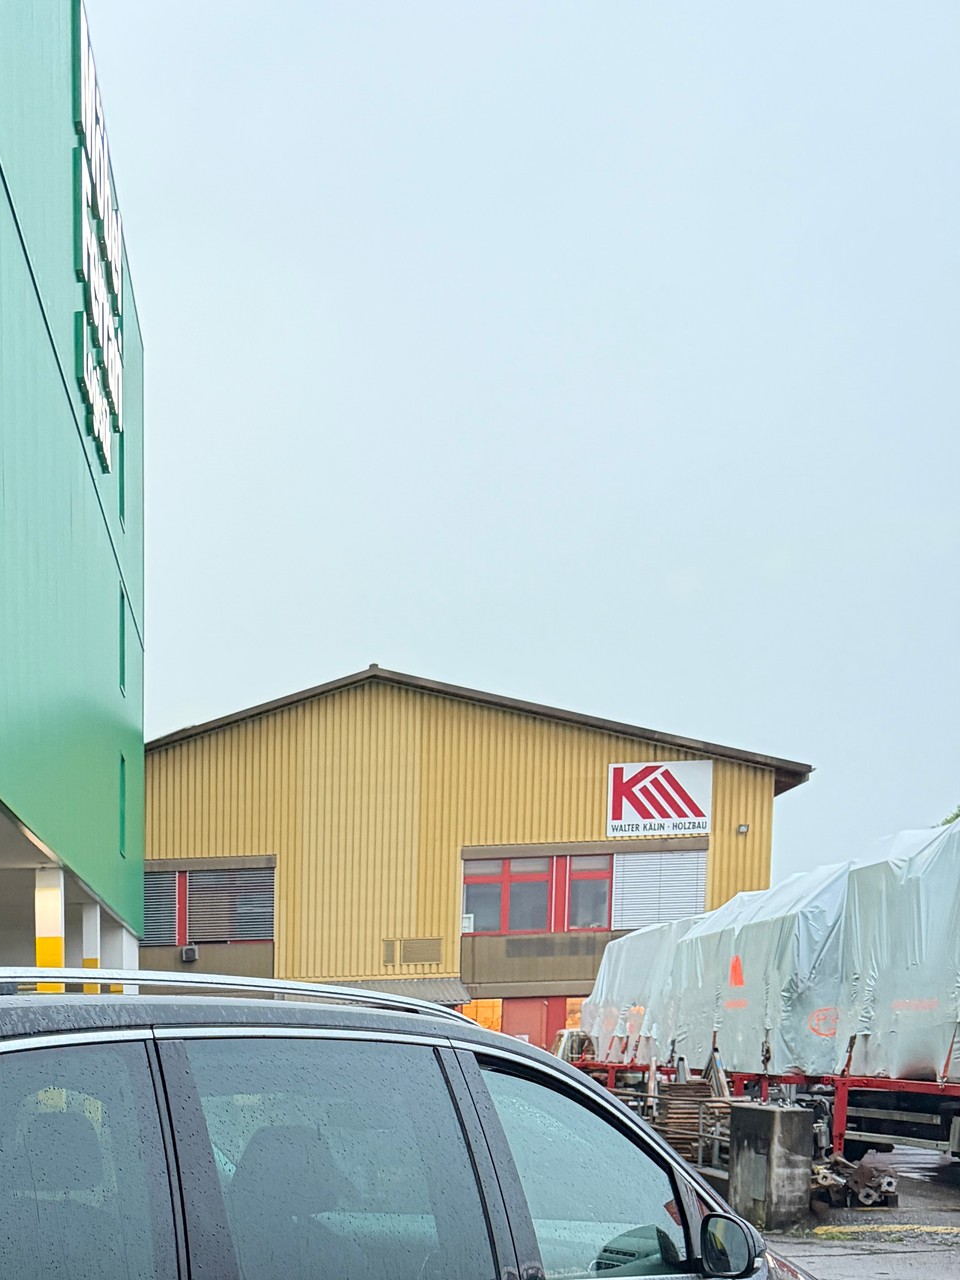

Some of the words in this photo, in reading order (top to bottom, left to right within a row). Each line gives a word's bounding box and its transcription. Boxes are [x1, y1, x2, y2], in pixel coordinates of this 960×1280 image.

[611, 823, 640, 832] WALTER
[643, 821, 665, 831] KÄLIN
[672, 821, 707, 831] HOLZBAU
